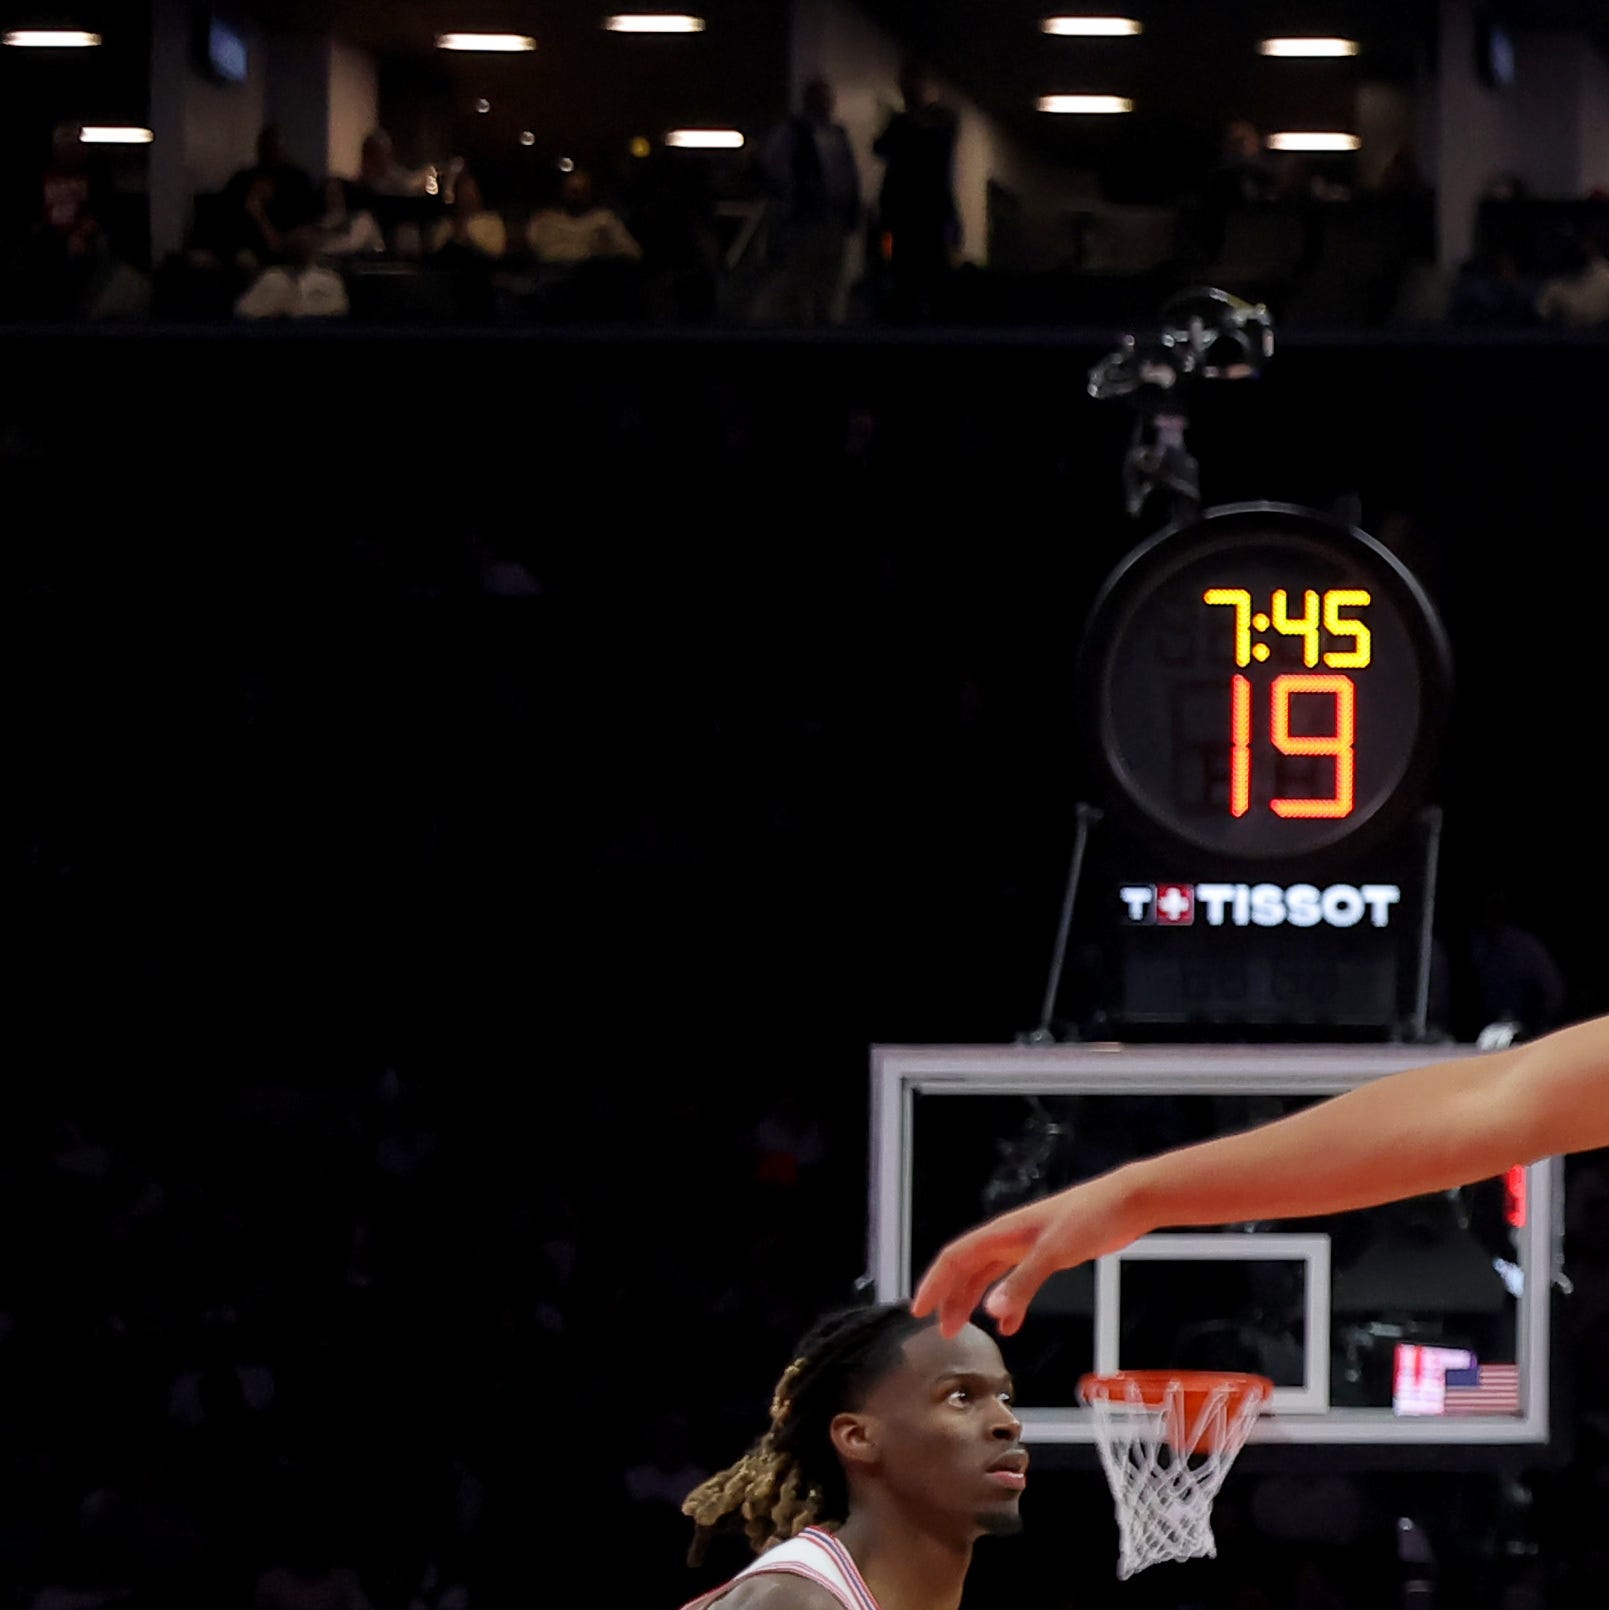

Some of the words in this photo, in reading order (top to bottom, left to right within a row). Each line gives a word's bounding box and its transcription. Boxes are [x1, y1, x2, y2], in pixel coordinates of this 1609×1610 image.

[1202, 587, 1372, 670] 7:45
[1230, 673, 1356, 819] 19
[1194, 883, 1401, 929] TISSOT
